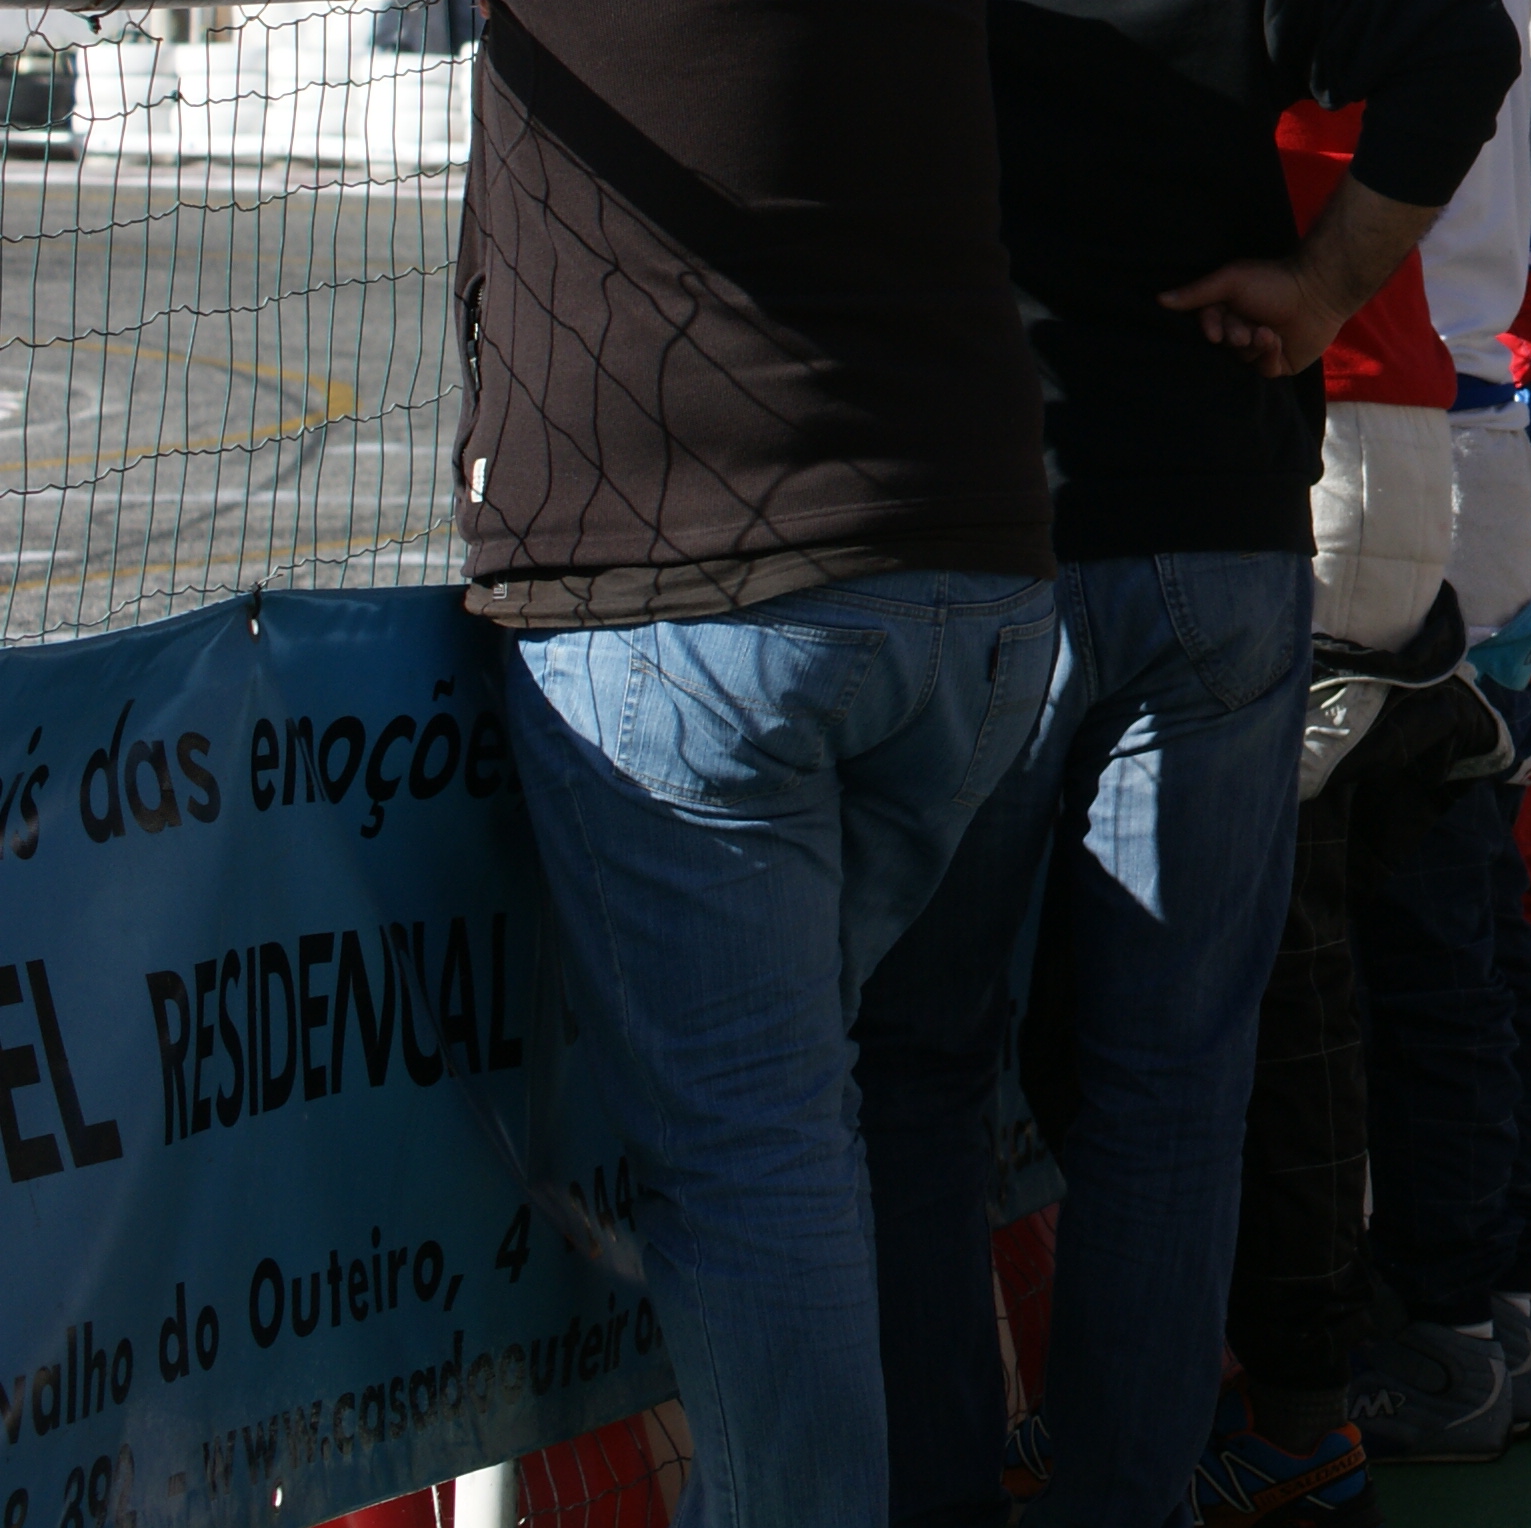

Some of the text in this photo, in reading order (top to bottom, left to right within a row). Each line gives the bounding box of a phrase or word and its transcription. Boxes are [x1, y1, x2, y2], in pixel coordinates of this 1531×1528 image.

[79, 698, 222, 844] das
[158, 1281, 220, 1384] do
[248, 1226, 466, 1352] Outeiro,
[494, 1202, 531, 1284] 4
